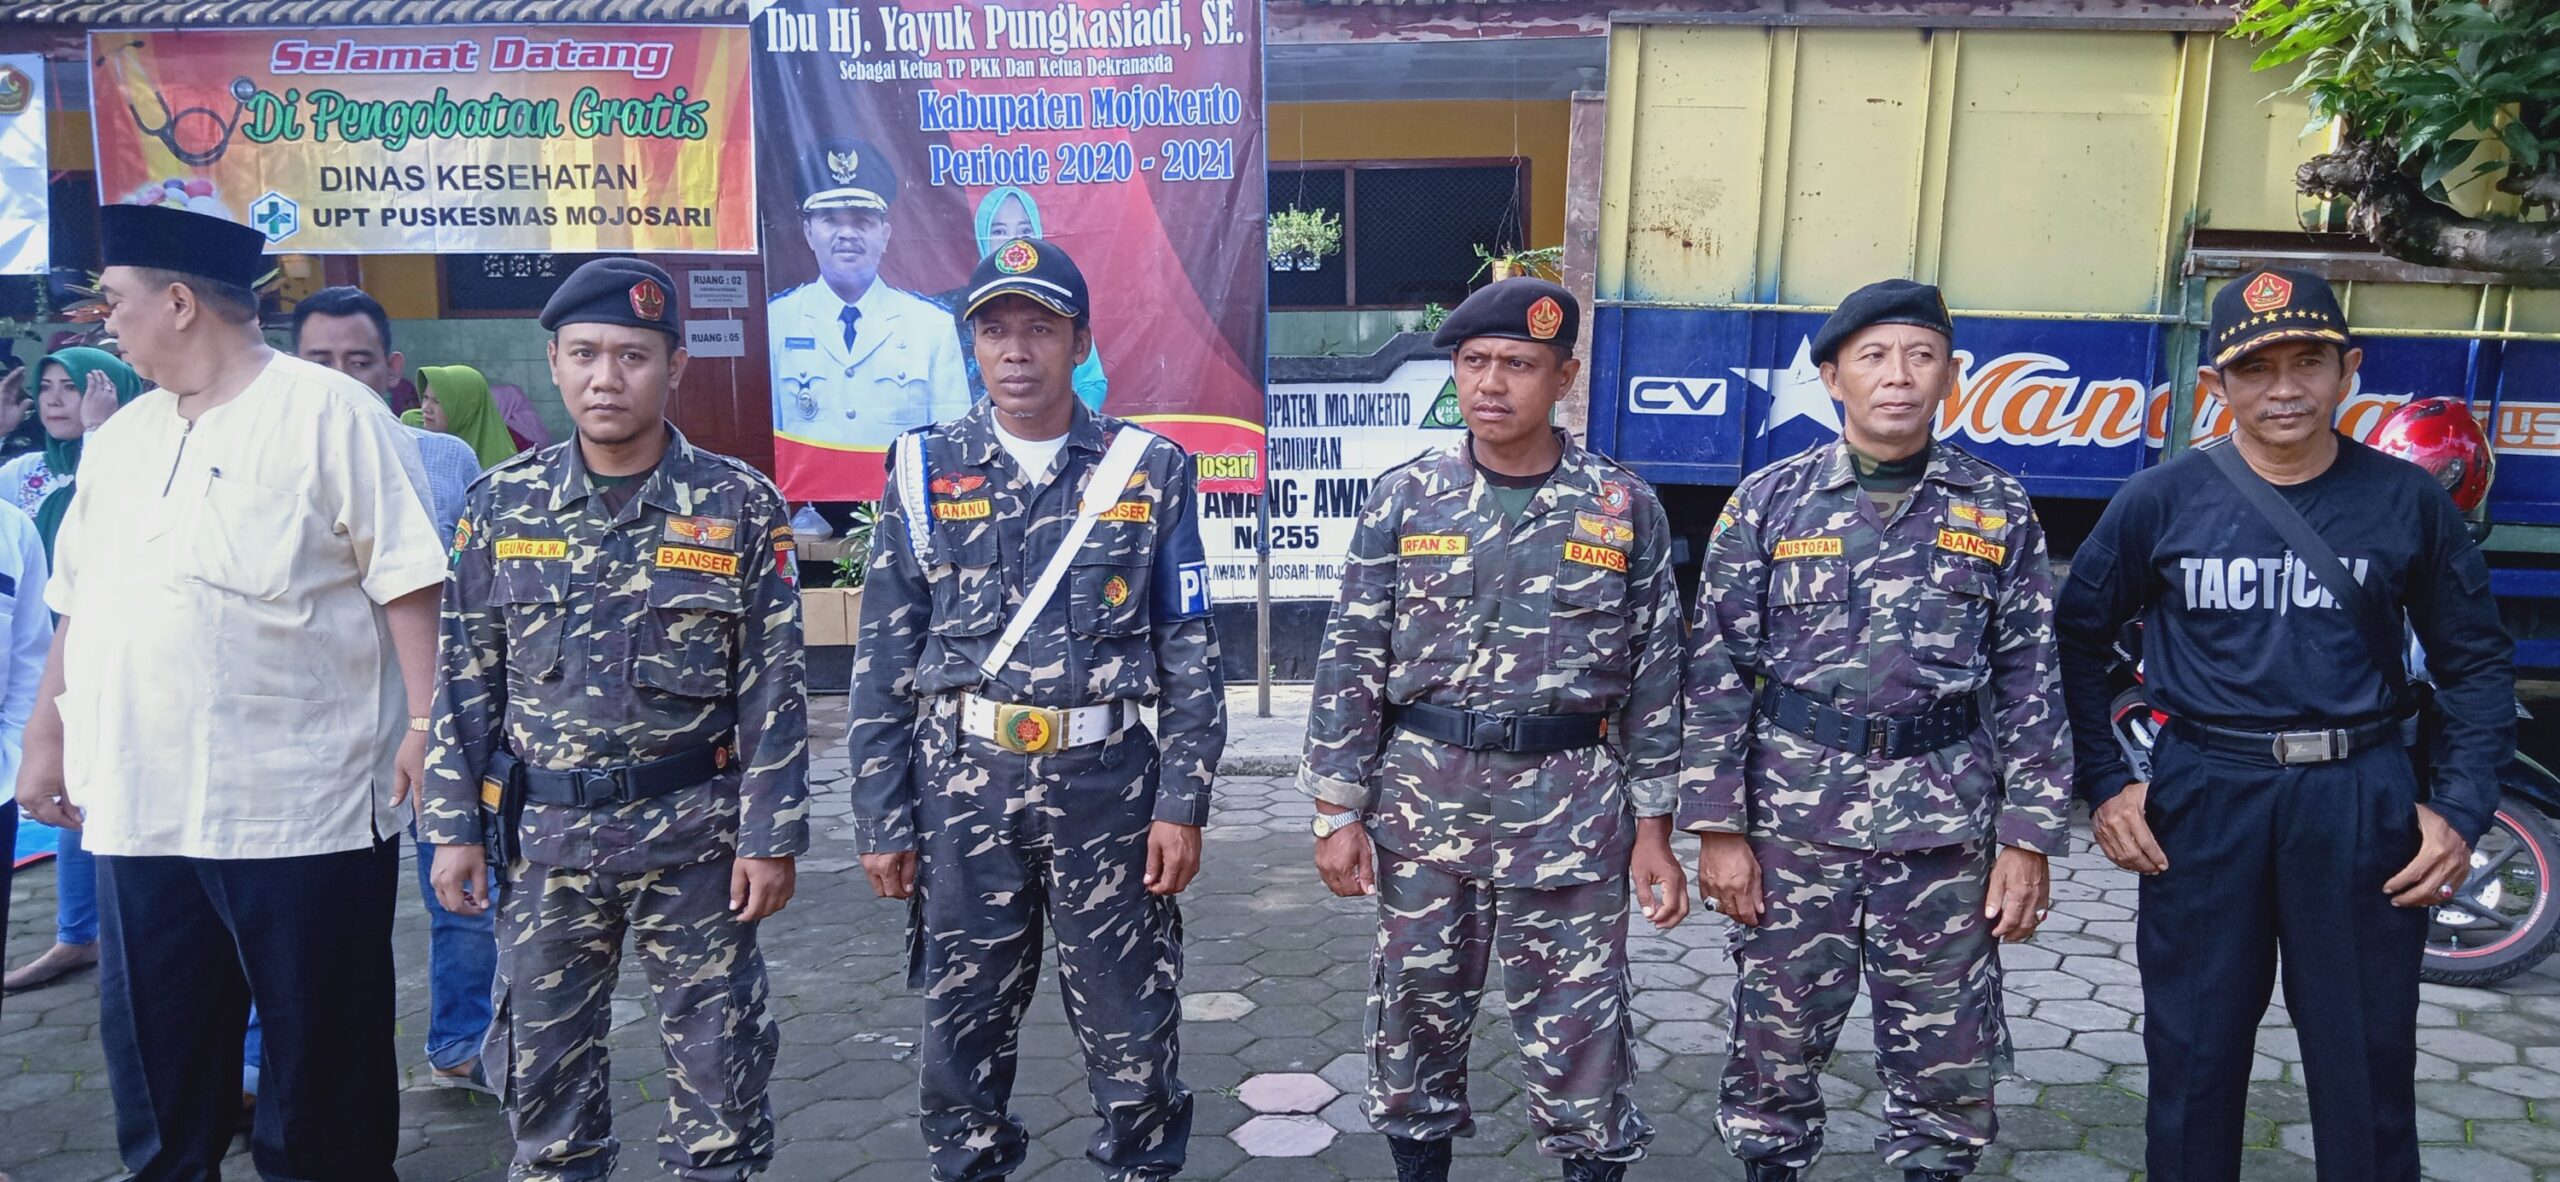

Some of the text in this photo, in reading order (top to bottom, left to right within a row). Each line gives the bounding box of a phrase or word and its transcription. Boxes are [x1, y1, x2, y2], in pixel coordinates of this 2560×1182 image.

[766, 0, 1245, 57] Ibu Hj. Yayuk Pungkasiadi, SE.
[271, 37, 674, 78] Selamat Datang
[840, 53, 1174, 82] Sebagai Ketua TP PKK Dan Ketua Dekranasda
[242, 87, 709, 151] Di Pengobatan Gratis
[918, 83, 1241, 134] Kabupaten Mojokerto
[929, 138, 1234, 186] Periode 2020 - 2021
[320, 164, 637, 192] DINAS KESEHATAN
[313, 207, 712, 227] UPT PUSKESMAS MOJOSARI
[693, 275, 724, 285] RUANG
[732, 276, 742, 285] 02
[691, 333, 722, 343] RUANG
[729, 333, 740, 342] 05
[1325, 392, 1411, 427] MOJOKERTO
[1633, 380, 1722, 411] CV
[498, 541, 532, 556] AGUNG
[1404, 538, 1459, 552] IRFAN S.
[1570, 544, 1626, 571] BANSE
[662, 550, 733, 572] BANSER
